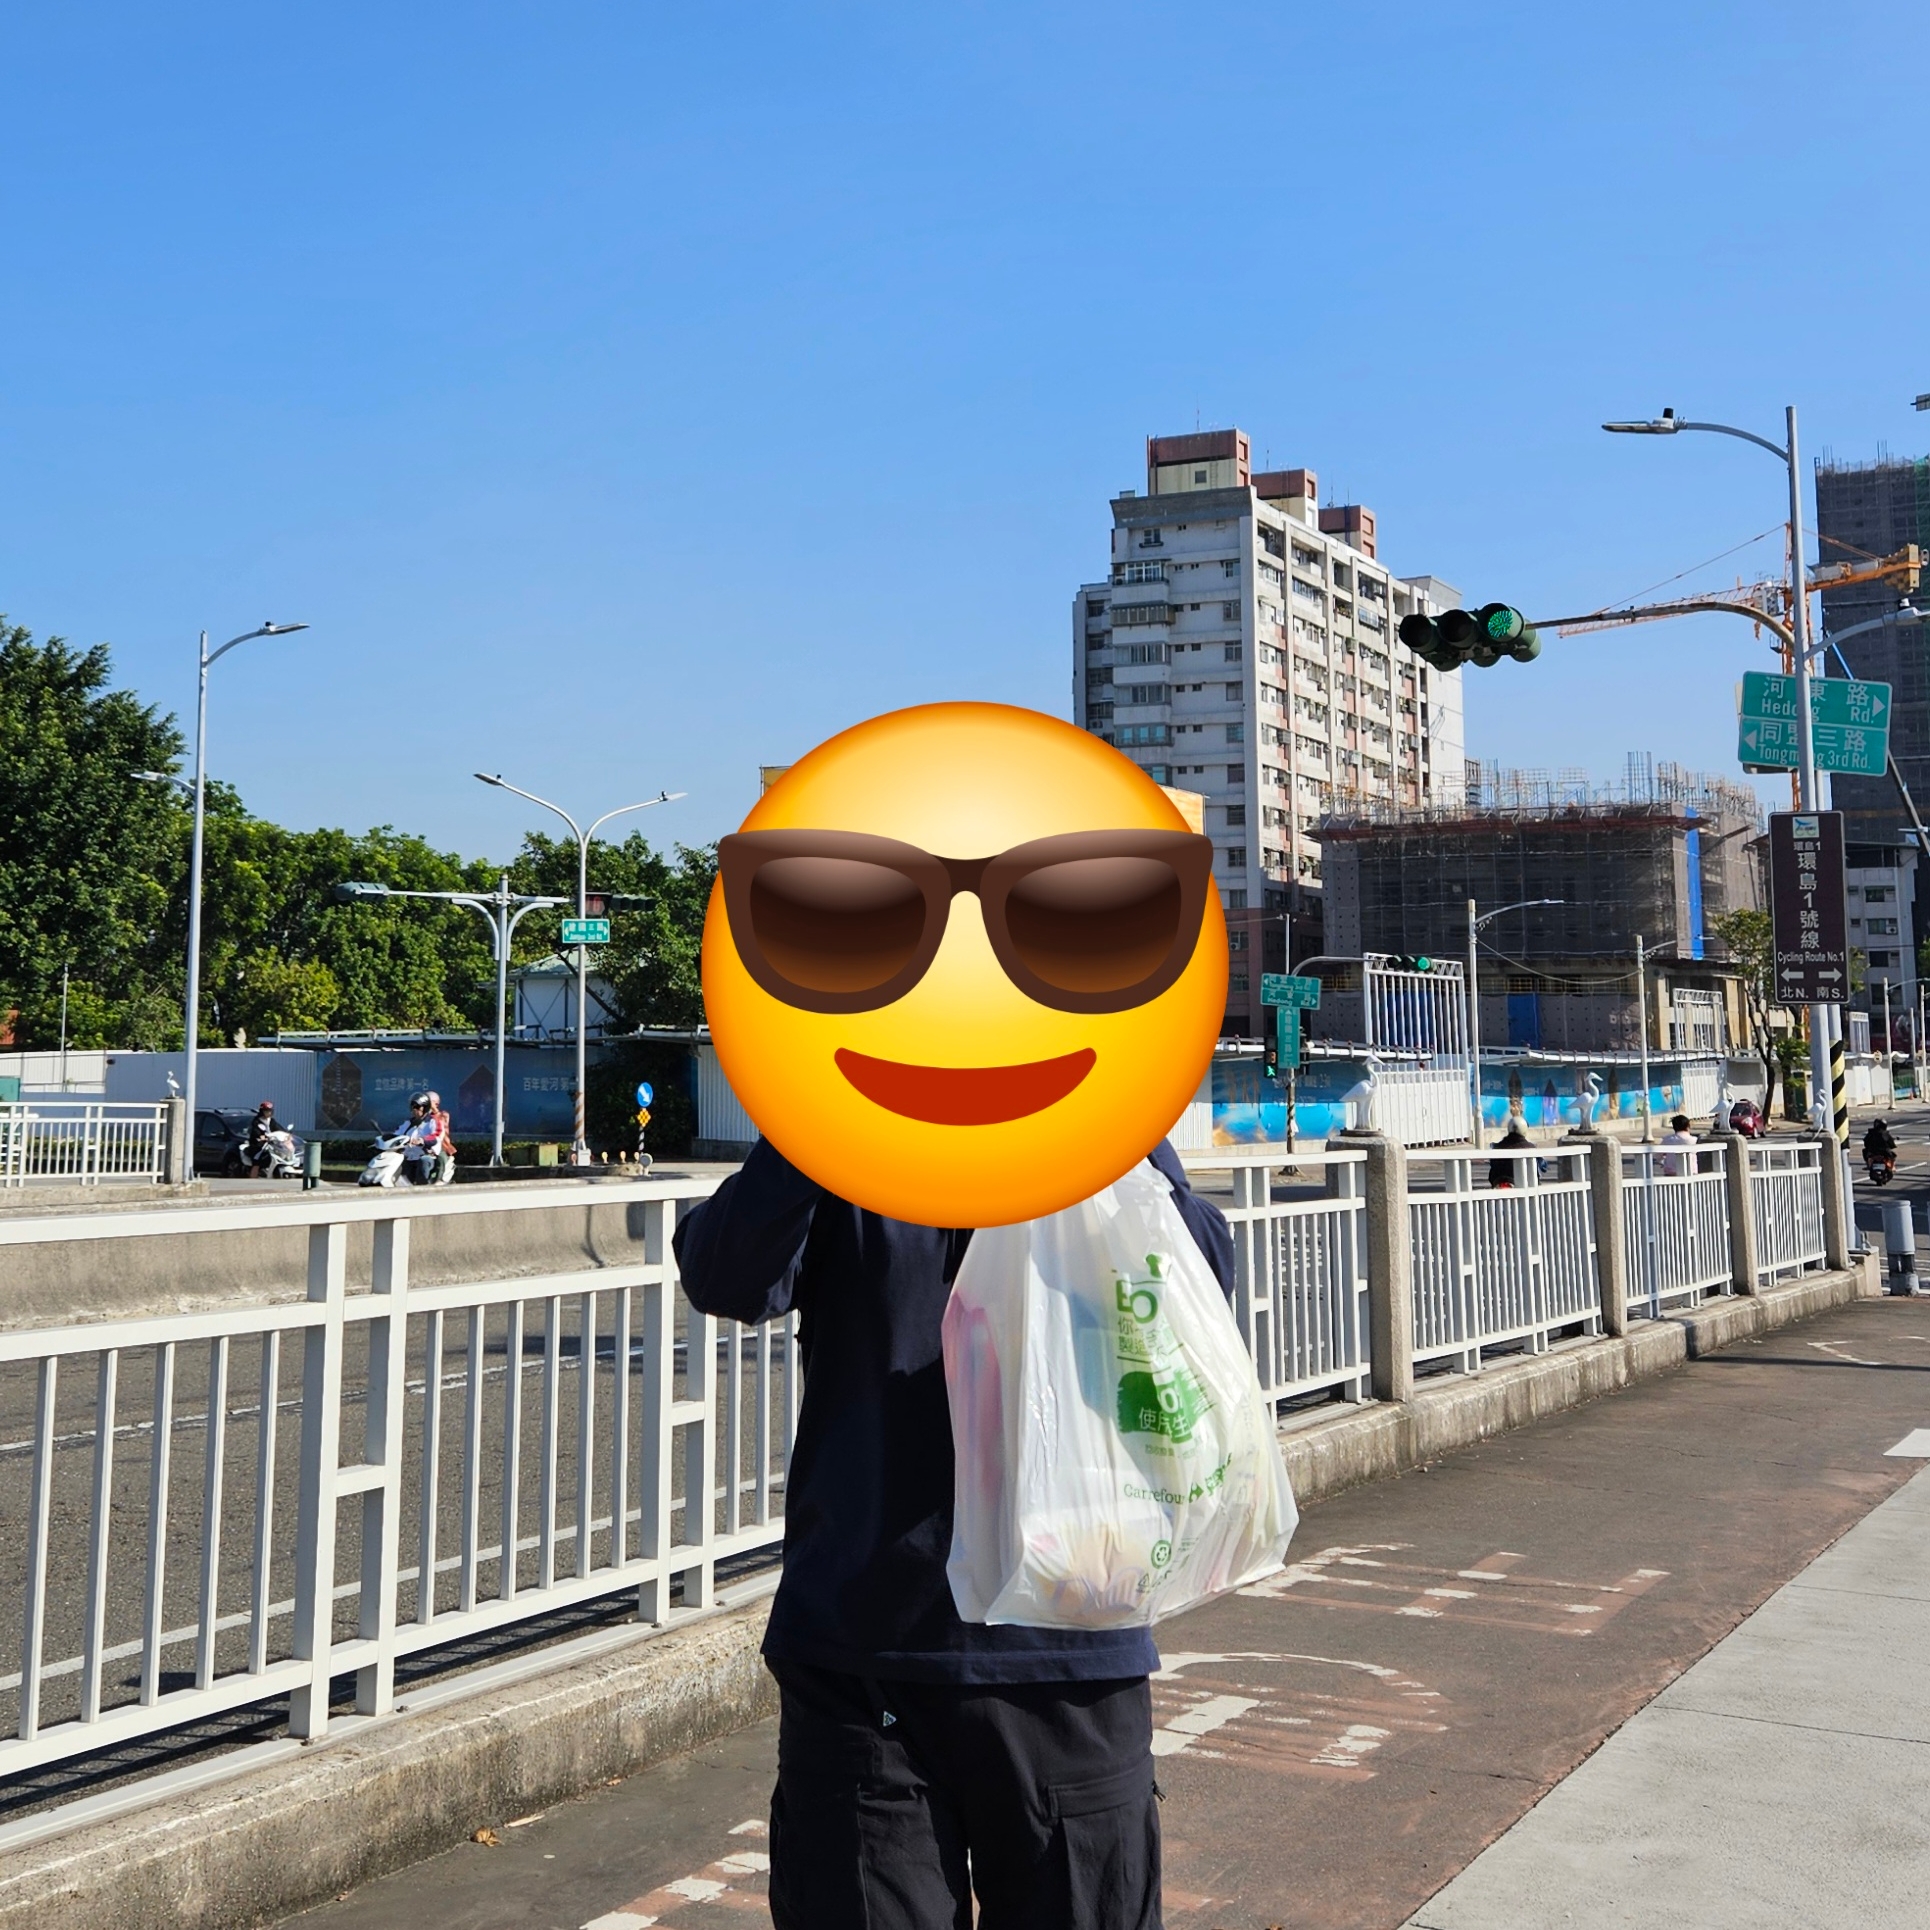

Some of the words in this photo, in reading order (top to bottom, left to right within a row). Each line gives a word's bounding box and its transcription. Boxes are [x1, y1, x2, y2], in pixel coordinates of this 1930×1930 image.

[1762, 676, 1870, 707] 河東路
[1761, 698, 1820, 722] Hedog
[1850, 705, 1875, 724] Rd.
[1757, 743, 1824, 769] Tongmg
[1827, 750, 1849, 766] 3rd
[1851, 752, 1871, 769] Rd.
[1797, 851, 1820, 949] 環島1號線
[1777, 951, 1804, 965] Cycling
[1804, 951, 1826, 962] Route
[1827, 951, 1845, 962] No.1
